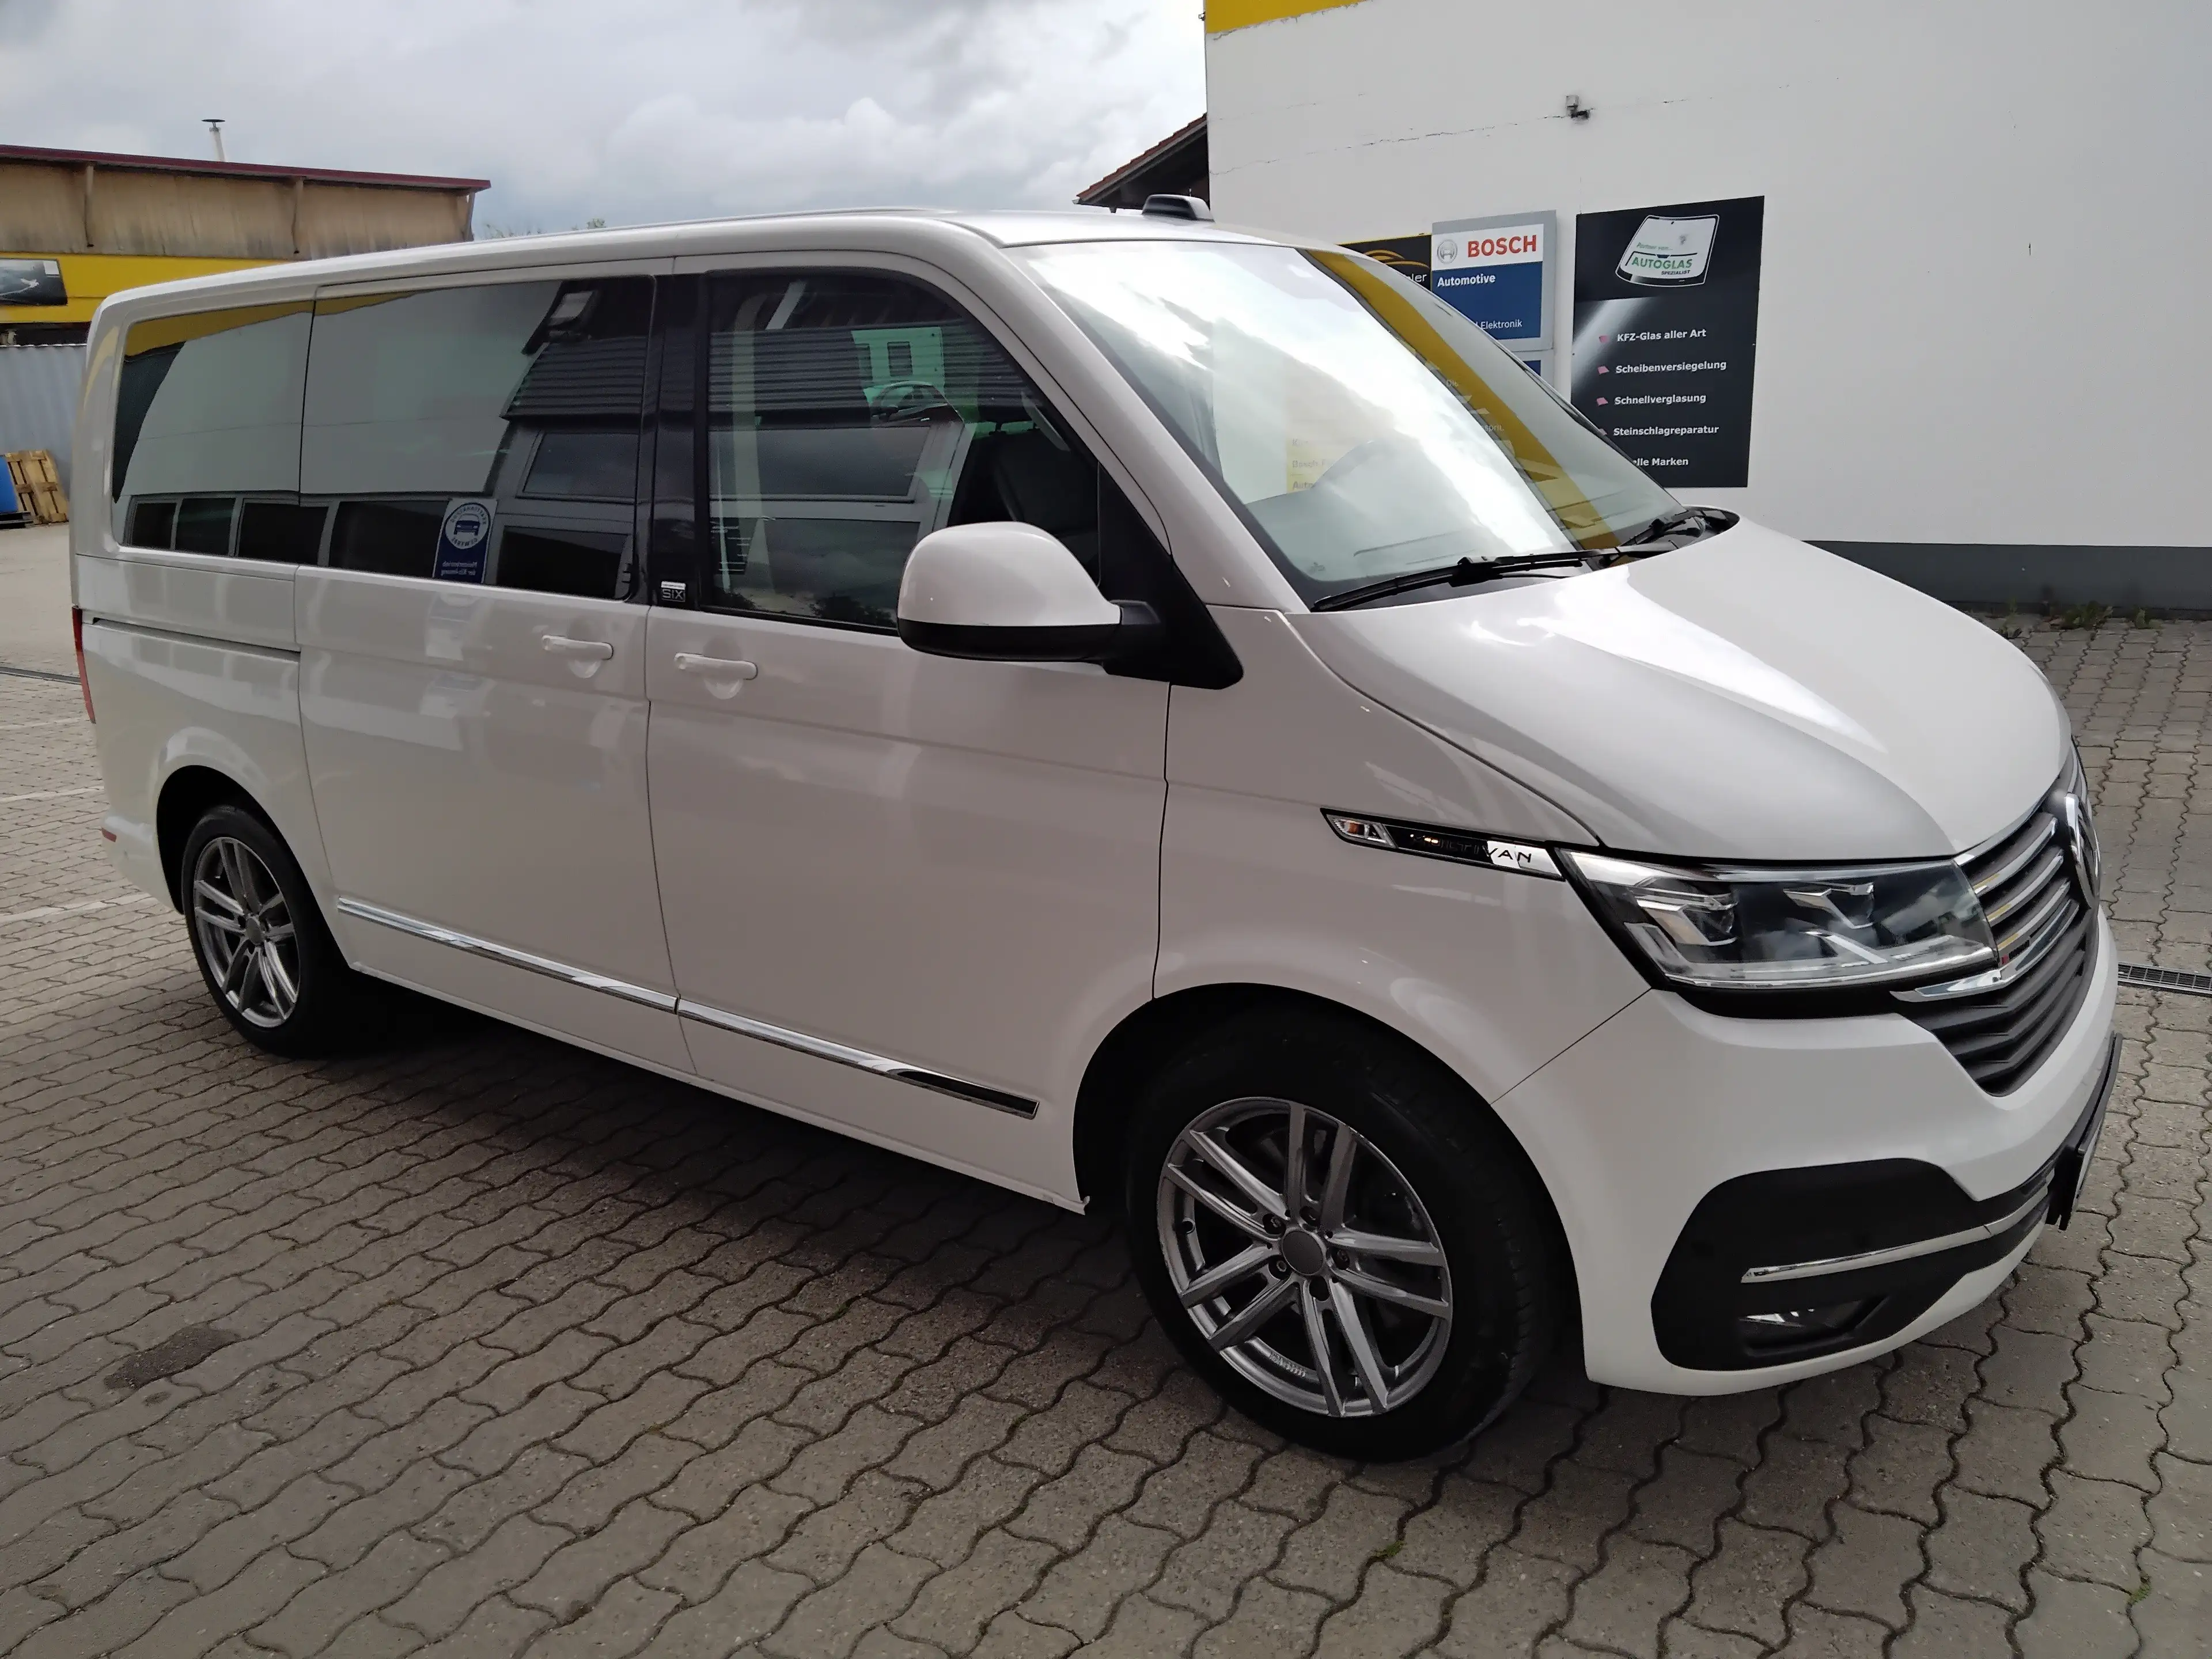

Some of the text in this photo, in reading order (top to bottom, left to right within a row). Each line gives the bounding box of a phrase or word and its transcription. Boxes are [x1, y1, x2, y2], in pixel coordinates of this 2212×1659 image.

[1468, 234, 1537, 258] BOSCH
[1631, 257, 1693, 270] AUTOGLAS
[1437, 273, 1496, 287] Automotive
[1480, 319, 1522, 329] Elektronik
[1617, 329, 1706, 342] KFZ-Glas aller Art
[1616, 361, 1727, 373] Scheibenversiegelung
[1615, 394, 1707, 404] Schnellverglasung
[1613, 425, 1719, 436] Steinschlagreparatur
[1652, 457, 1689, 466] Marken
[662, 588, 683, 600] SIX
